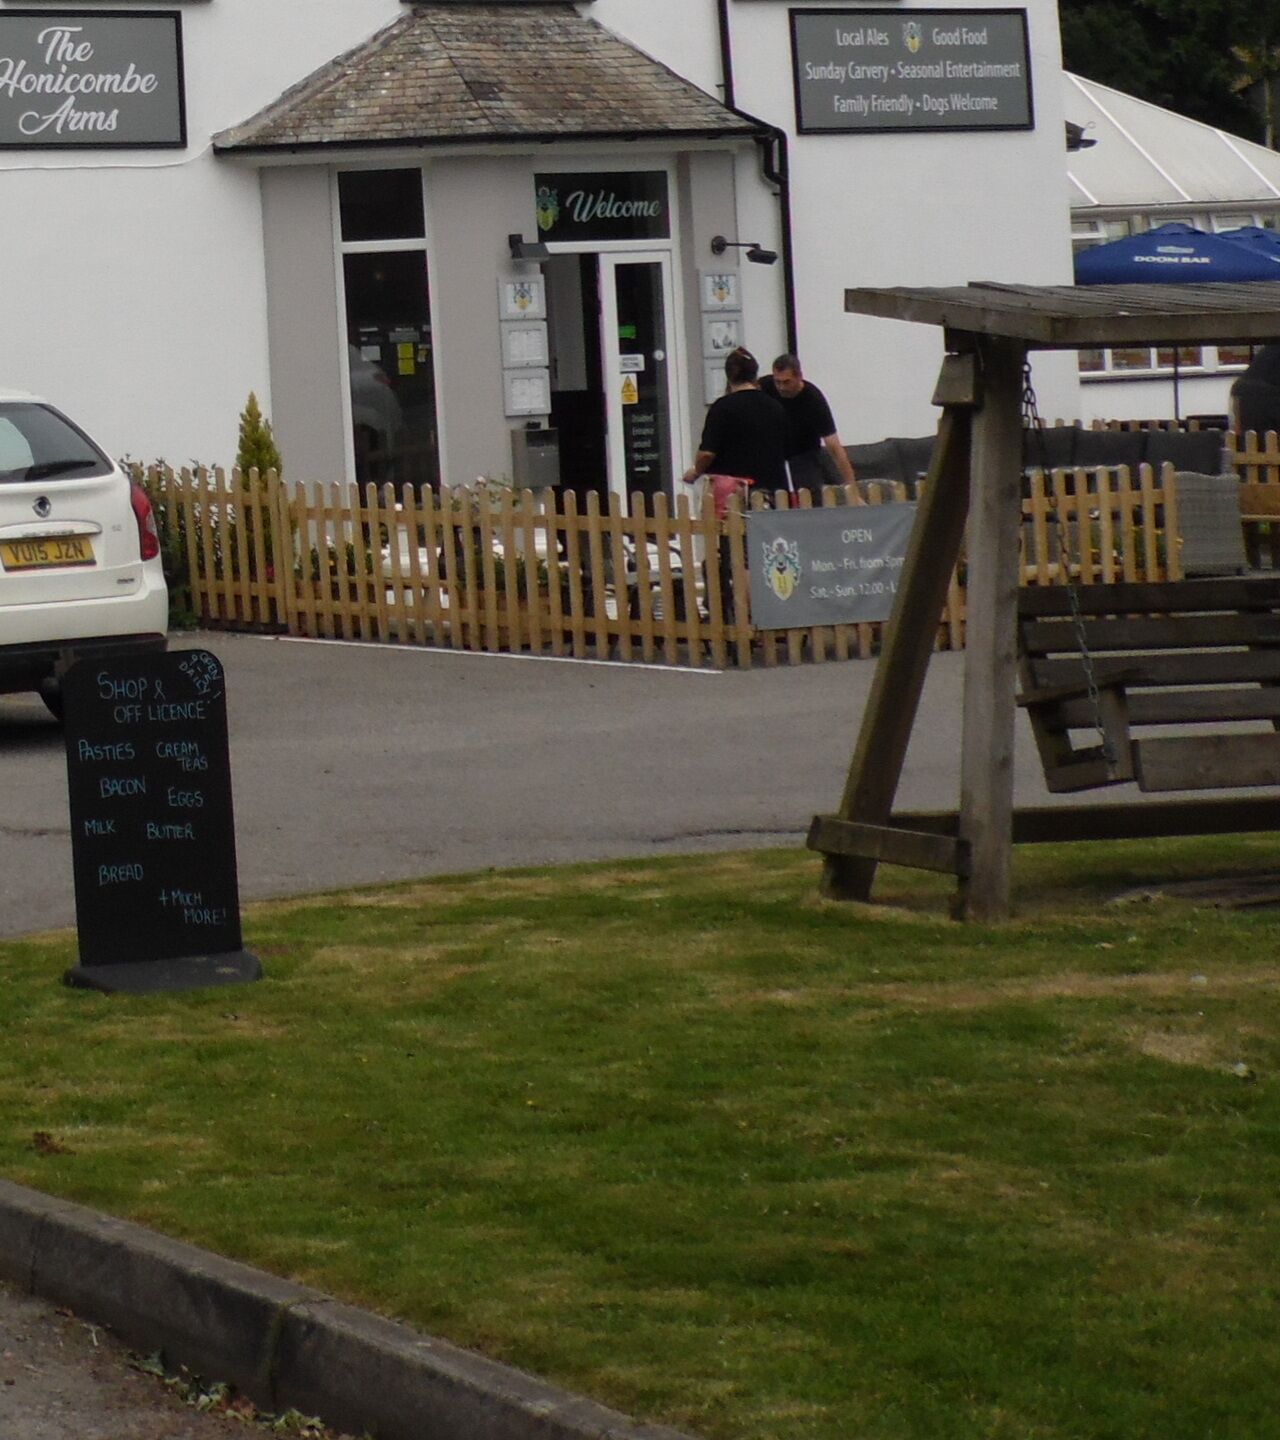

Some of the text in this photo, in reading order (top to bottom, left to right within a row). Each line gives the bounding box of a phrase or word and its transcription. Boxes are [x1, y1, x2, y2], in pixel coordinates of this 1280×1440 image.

[38, 26, 94, 63] The
[836, 28, 889, 46] Local Ales
[932, 27, 988, 46] Good Food
[805, 62, 1020, 83] Sunday Carvery Seasonal Entertainment
[834, 93, 999, 116] Family Friendly Dogs Welcome
[19, 95, 119, 136] Arms
[566, 190, 661, 223] Welcome
[841, 529, 872, 543] OPEN
[55, 540, 86, 559] JZN
[859, 557, 884, 568] from
[97, 671, 148, 700] SHOP
[114, 702, 206, 723] OFF LICENCE
[78, 739, 135, 761] PASTIES
[156, 741, 200, 758] CREAM
[177, 757, 208, 771] TEAS
[100, 775, 146, 798] BACON
[168, 787, 204, 807] EGGS
[85, 820, 116, 836] MILK
[147, 823, 196, 840] BUTTER
[98, 864, 144, 886] BREAD
[171, 890, 202, 906] MUCH
[184, 907, 227, 926] MORE!
